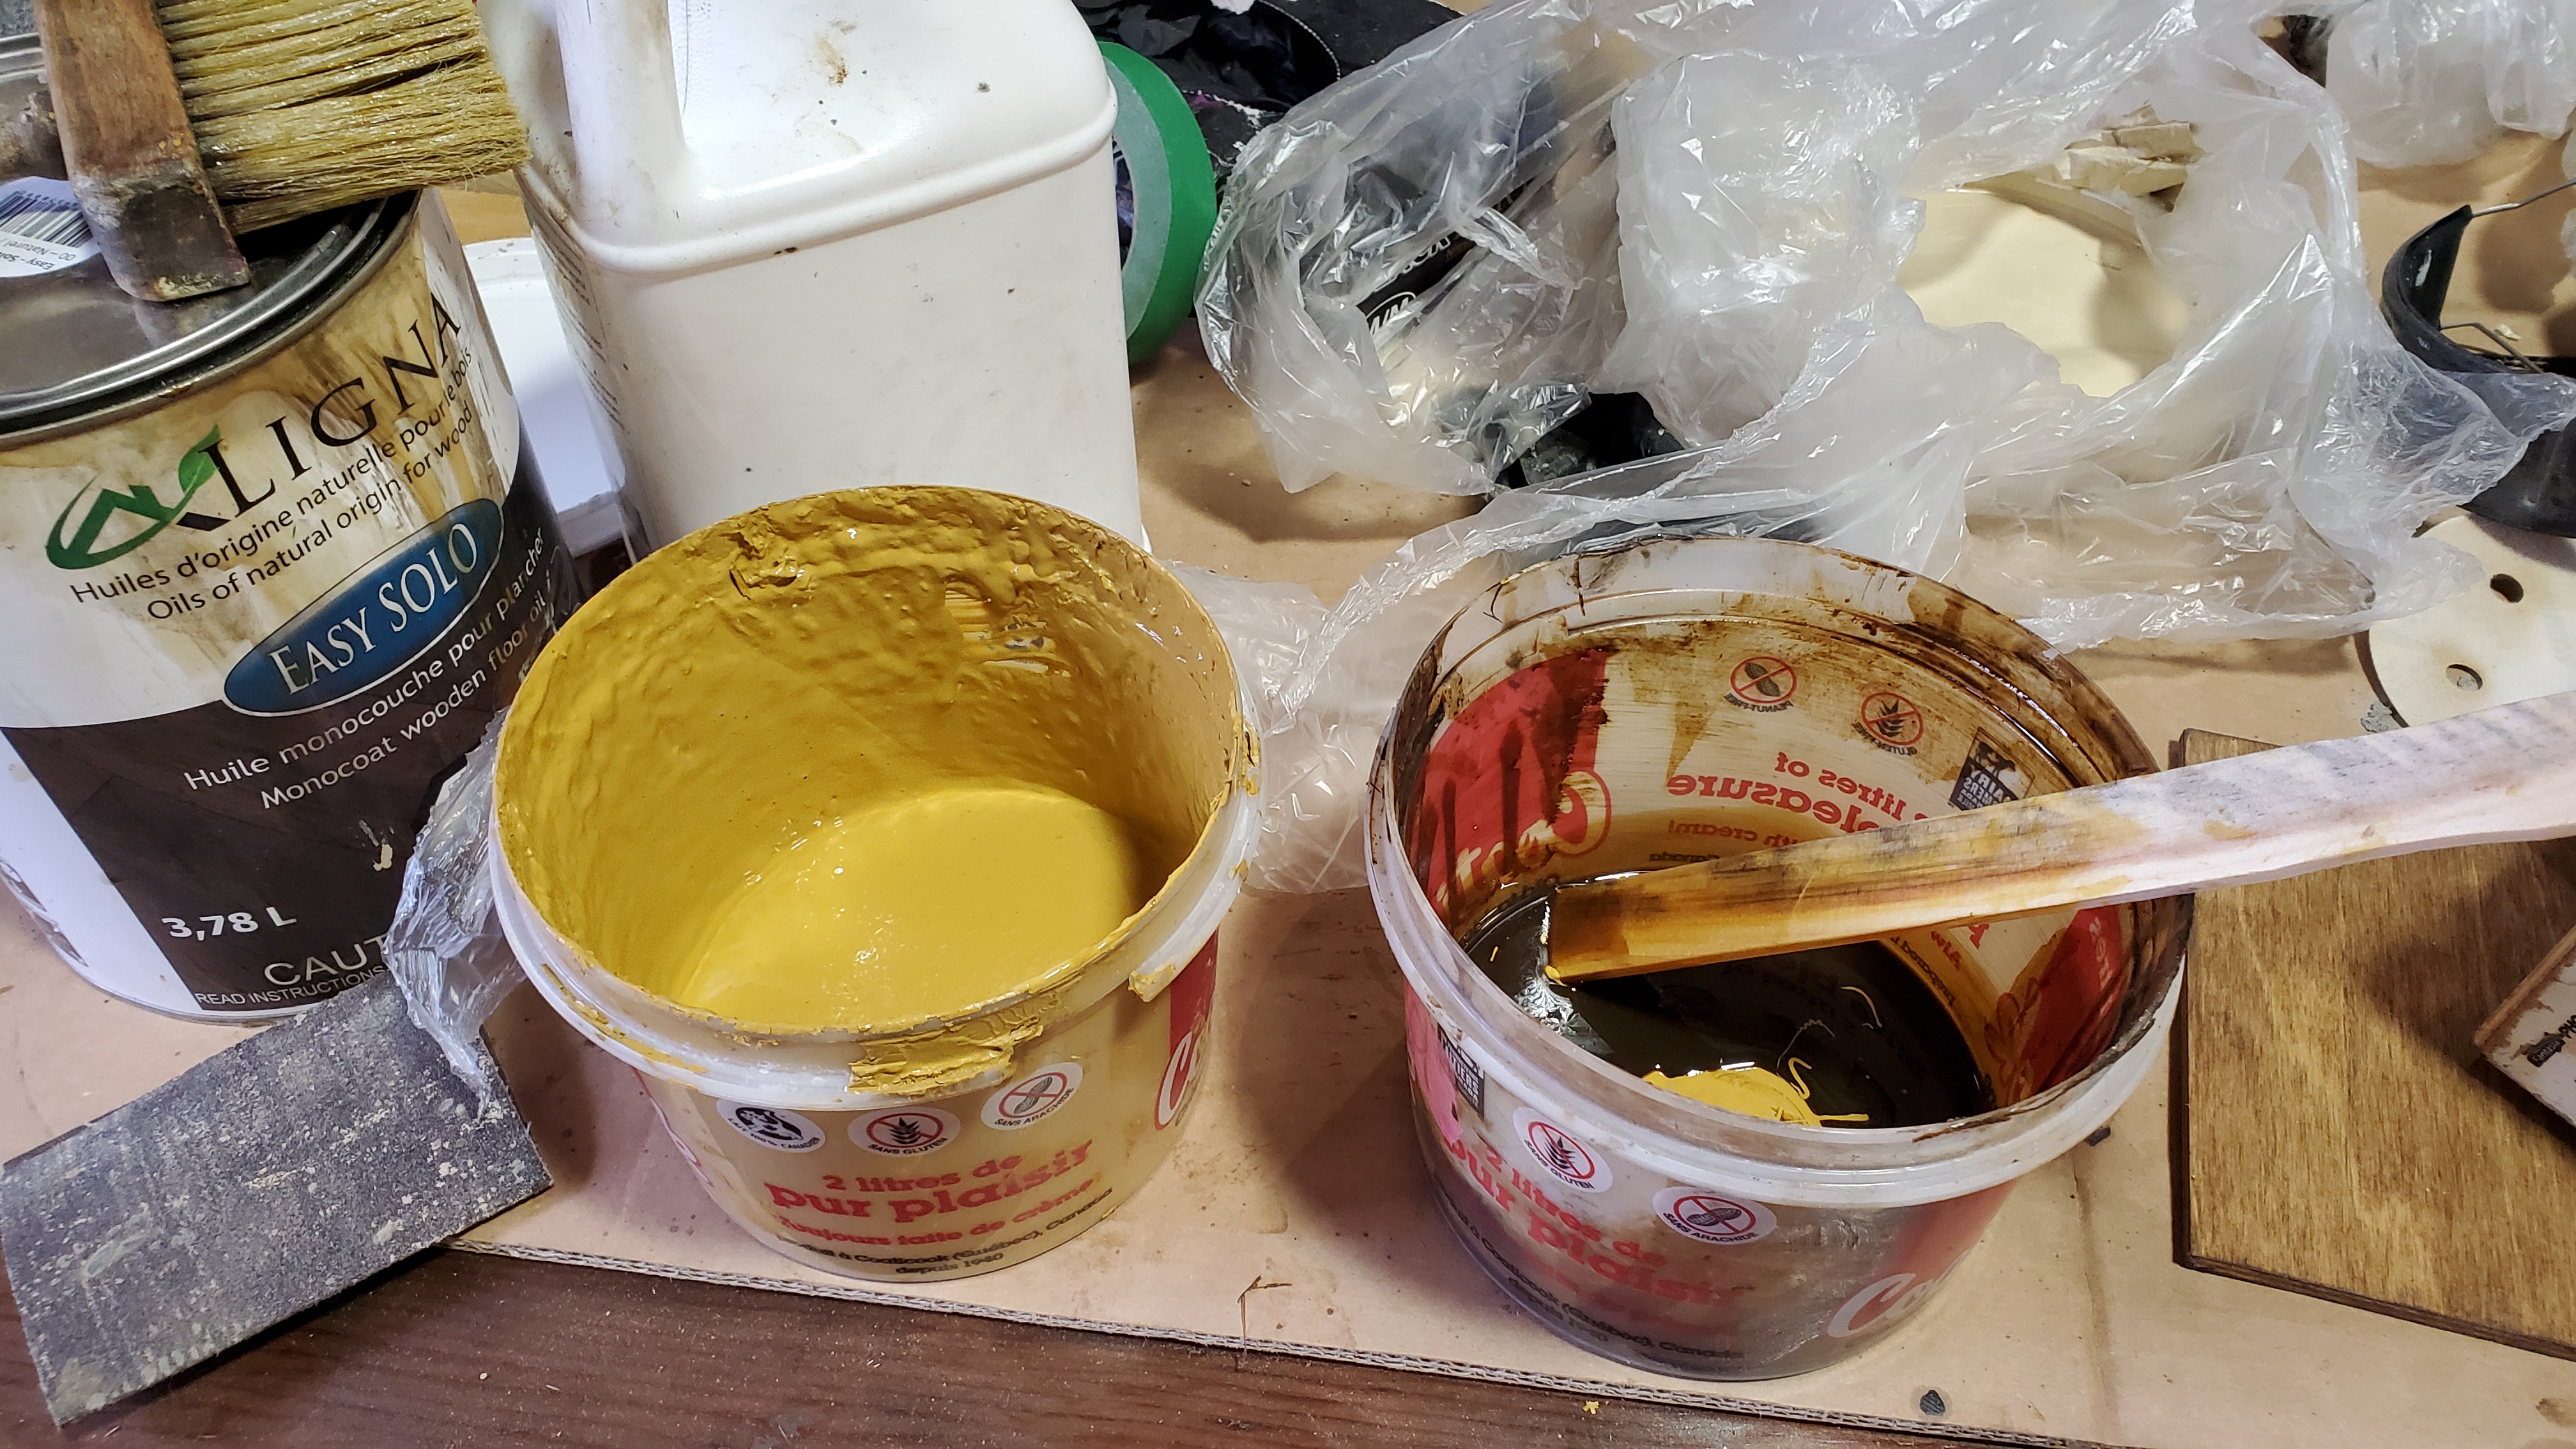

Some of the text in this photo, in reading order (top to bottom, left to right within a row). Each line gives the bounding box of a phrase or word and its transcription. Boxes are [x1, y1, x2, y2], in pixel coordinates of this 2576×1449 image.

[26, 257, 55, 270] Easy
[198, 292, 461, 518] LIGNA
[70, 347, 471, 603] Huiles d'origine naturelle pour le bois
[148, 401, 472, 618] Oils of natural origin for wood
[267, 523, 477, 695] EASY SOLO
[184, 527, 543, 790] Huile monocouche pour plancher
[261, 590, 546, 809] Monocoat wooden floor oil
[162, 907, 297, 941] 3,78 L
[195, 965, 385, 1005] READ INSTRUCTIONS
[994, 1087, 1075, 1126] SANS ARACHIDE
[822, 1156, 1022, 1192] 2 litres de
[868, 1137, 948, 1154] SANS GLUTEN
[1524, 1139, 1595, 1190] SANS GLUTEN
[764, 1139, 1092, 1223] pur plaisir
[1487, 1145, 1503, 1173] 2
[1512, 1167, 1602, 1242] litres
[1662, 1213, 1759, 1242] SANS ARACHIDE
